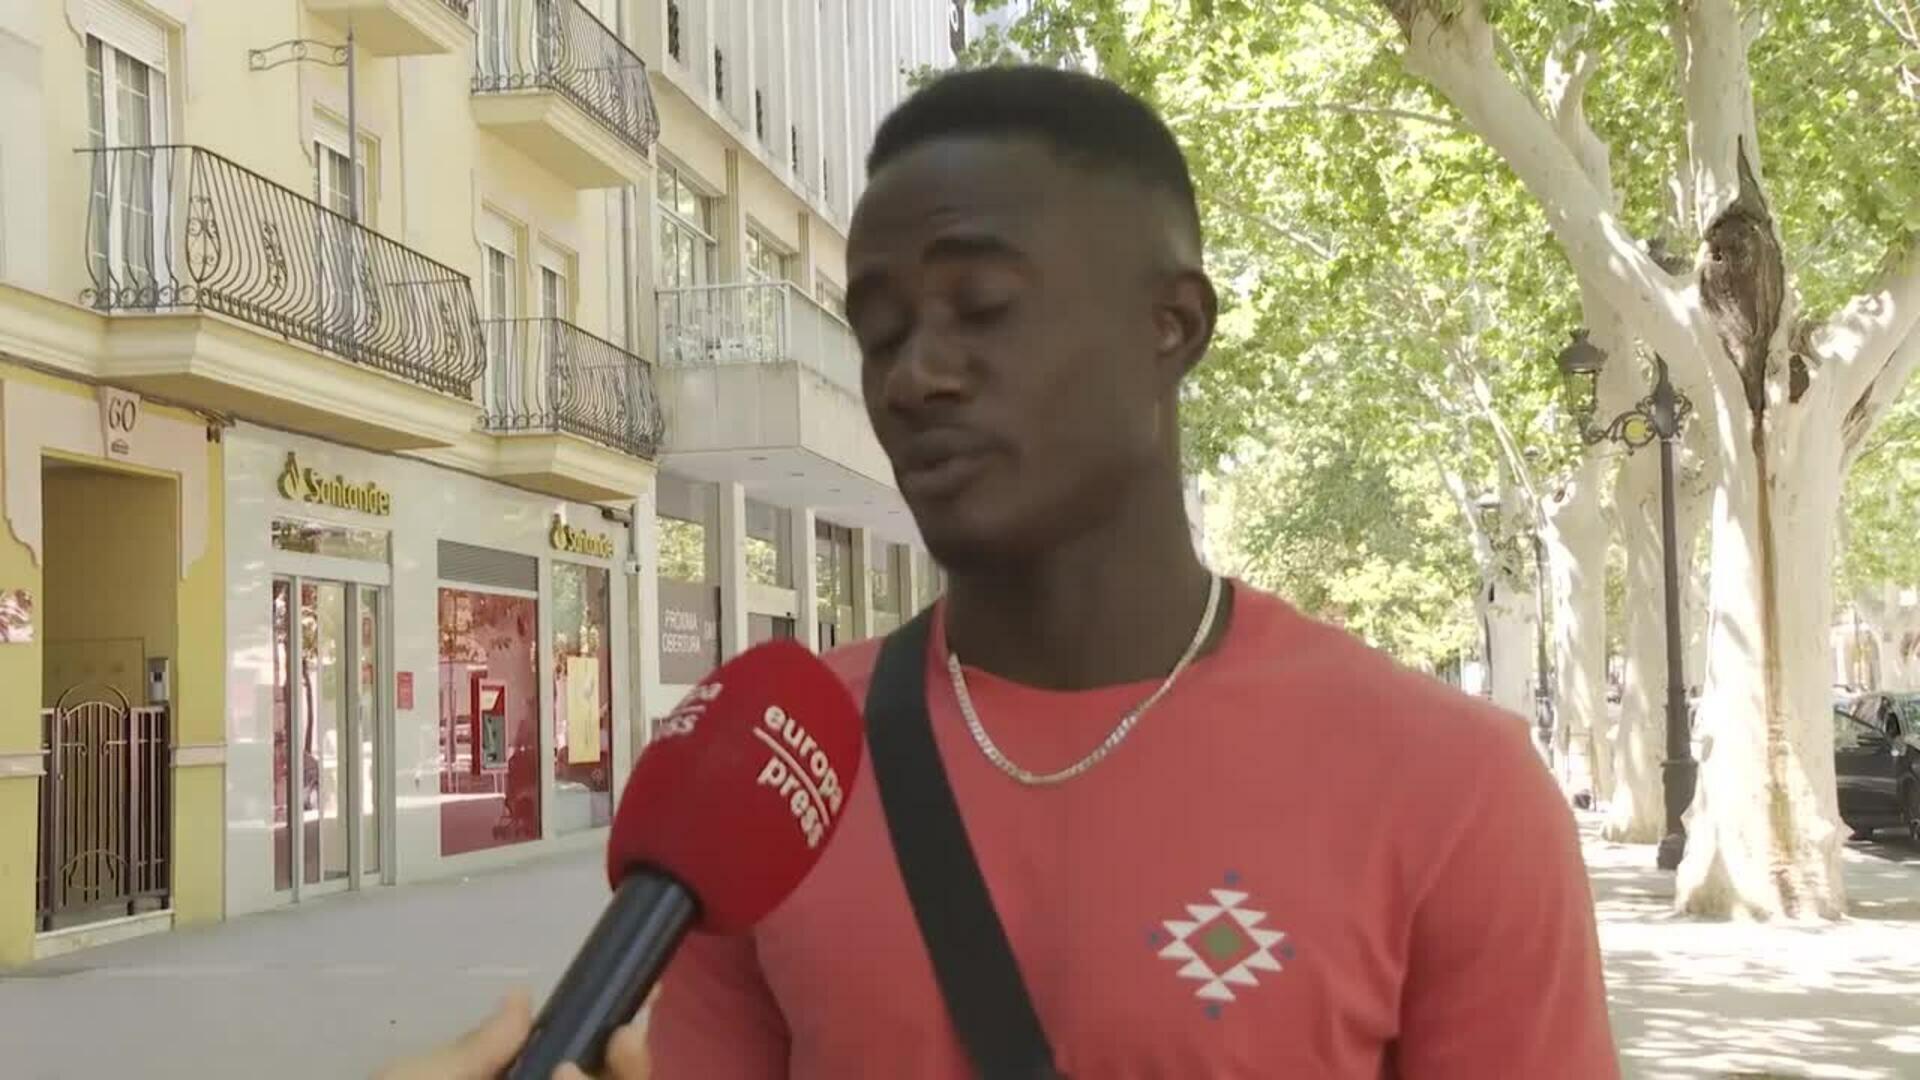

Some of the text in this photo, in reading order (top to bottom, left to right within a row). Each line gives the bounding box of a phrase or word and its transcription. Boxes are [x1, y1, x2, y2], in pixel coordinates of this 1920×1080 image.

[108, 397, 136, 432] 60
[757, 756, 824, 848] press
[764, 705, 844, 815] europa
